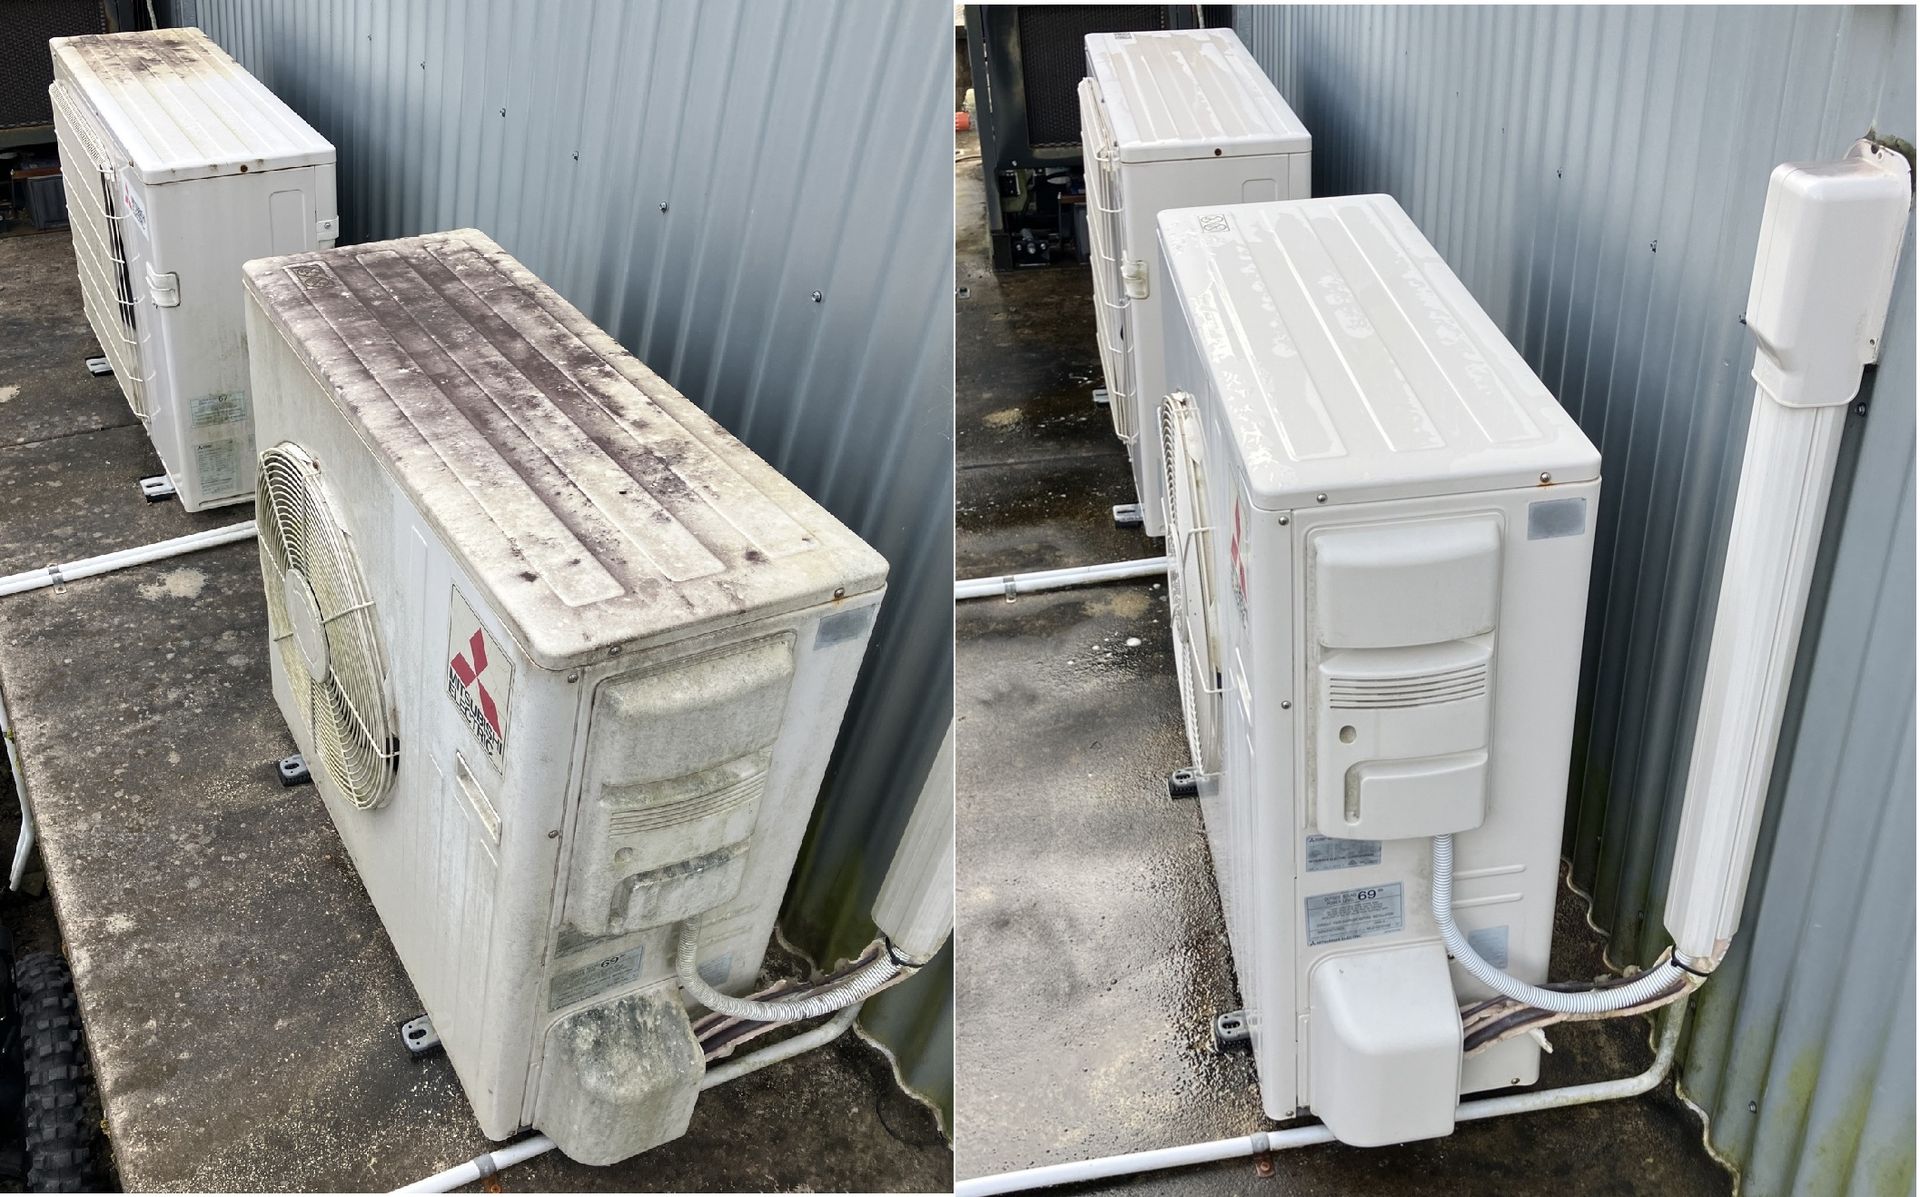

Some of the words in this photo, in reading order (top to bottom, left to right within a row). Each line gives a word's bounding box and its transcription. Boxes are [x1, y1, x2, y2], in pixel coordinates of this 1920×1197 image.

[448, 682, 493, 756] ELECTRIC
[449, 666, 502, 755] MITSUBISHI
[1358, 889, 1377, 900] 69
[600, 957, 619, 968] 69
